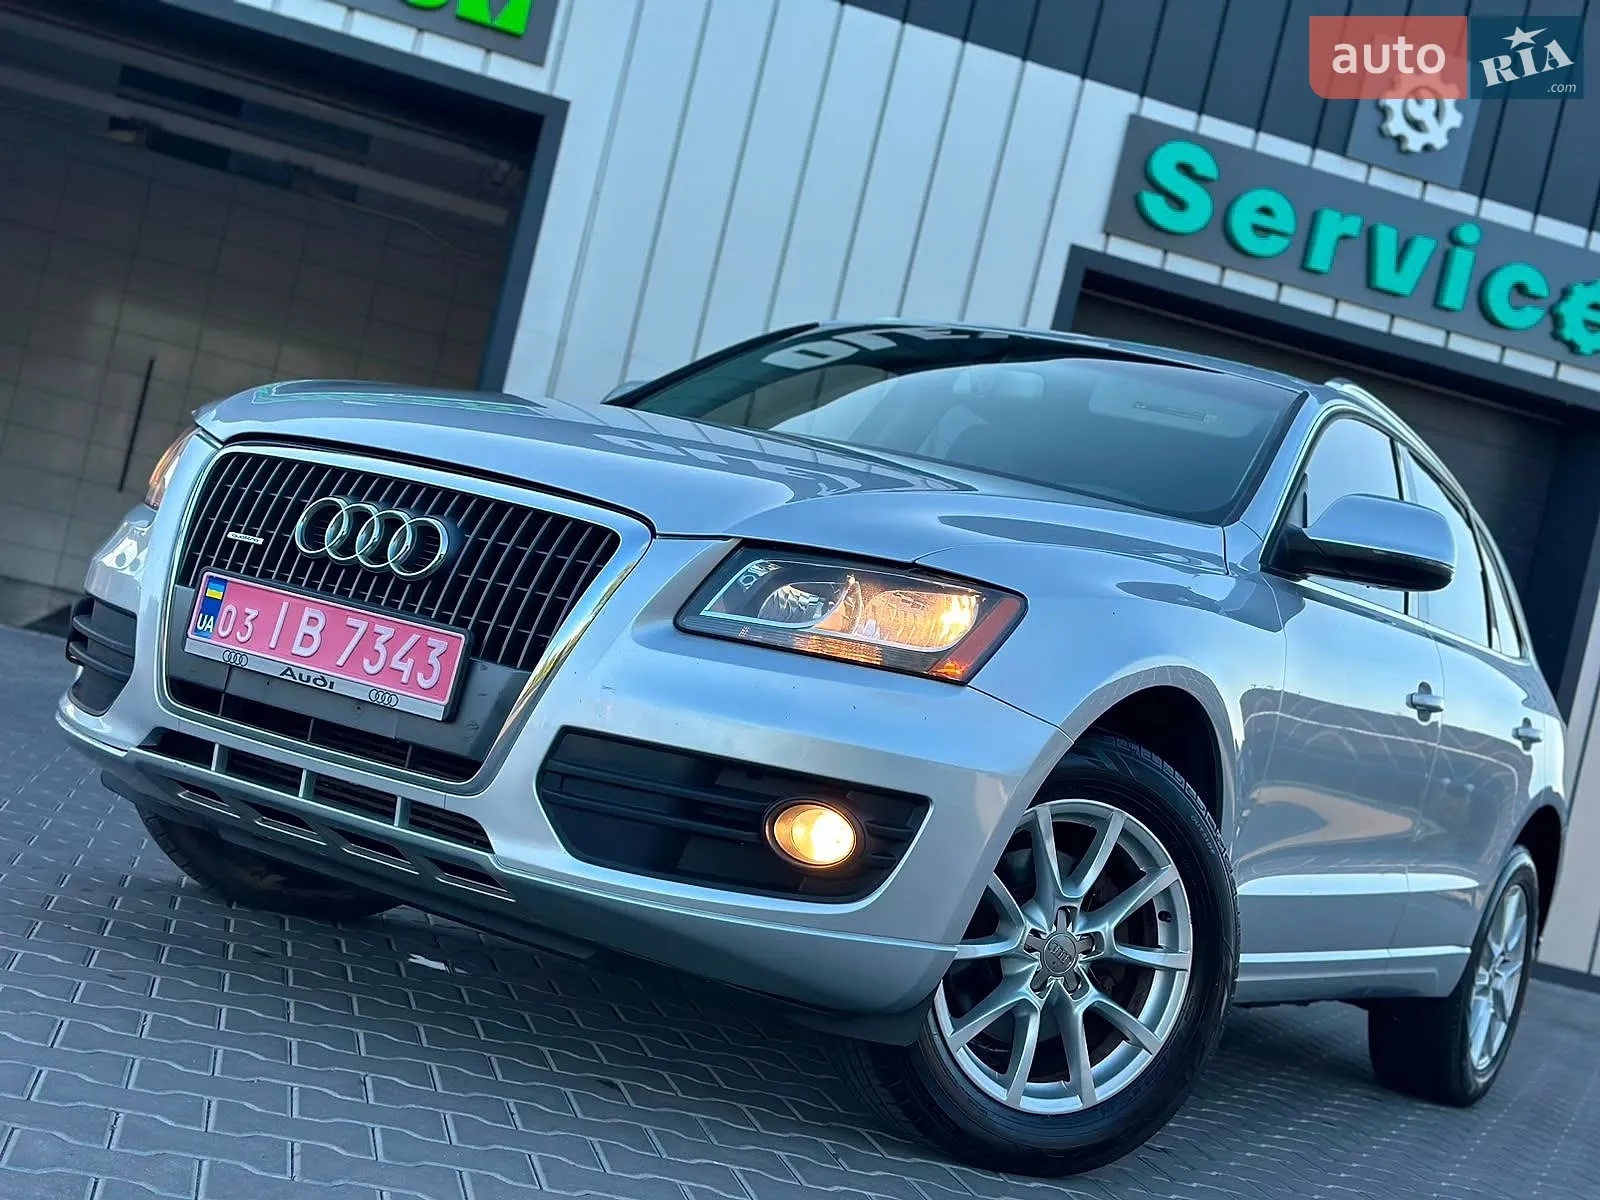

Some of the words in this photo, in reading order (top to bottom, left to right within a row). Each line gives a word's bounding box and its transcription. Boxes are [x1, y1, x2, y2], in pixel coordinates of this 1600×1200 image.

[197, 612, 214, 633] UA
[218, 604, 260, 643] 03
[268, 601, 327, 658] IB
[335, 617, 449, 690] 7343
[279, 666, 335, 690] Audi
